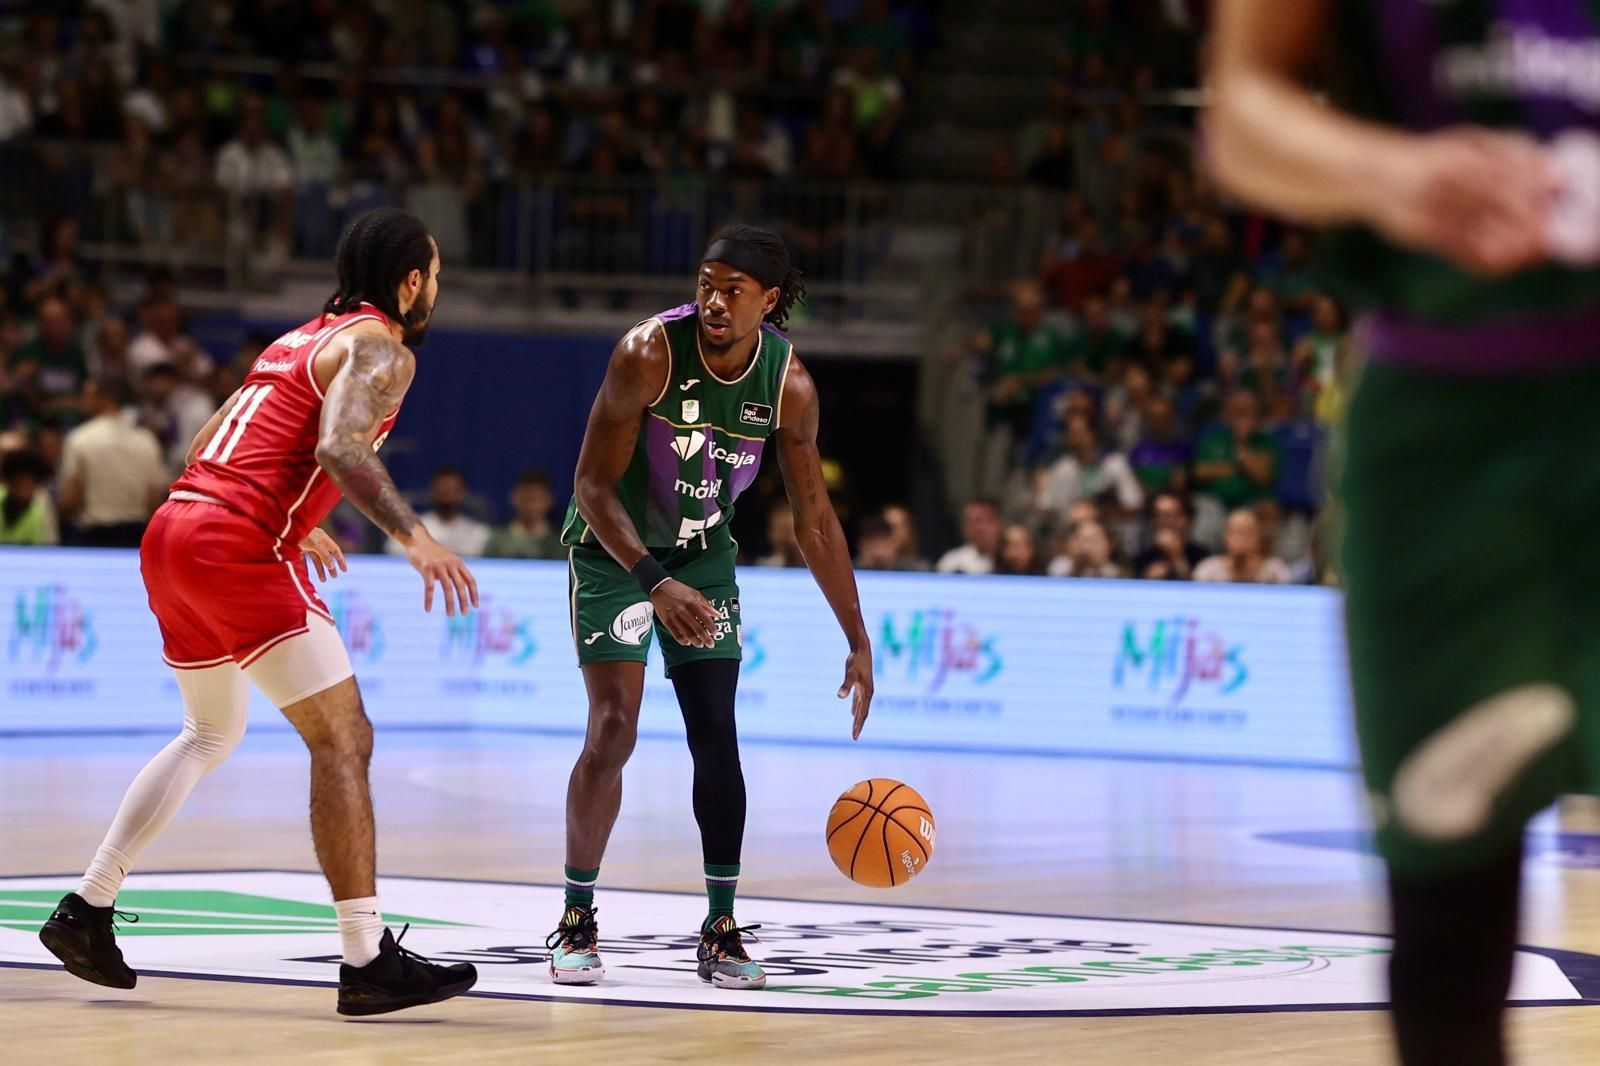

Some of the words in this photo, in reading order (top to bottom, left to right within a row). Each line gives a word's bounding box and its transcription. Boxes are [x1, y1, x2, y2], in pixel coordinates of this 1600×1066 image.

[201, 384, 275, 464] 11
[874, 606, 1003, 697] Mijas
[1112, 613, 1248, 705] Mijas
[756, 945, 1395, 1001] Baloncesto
